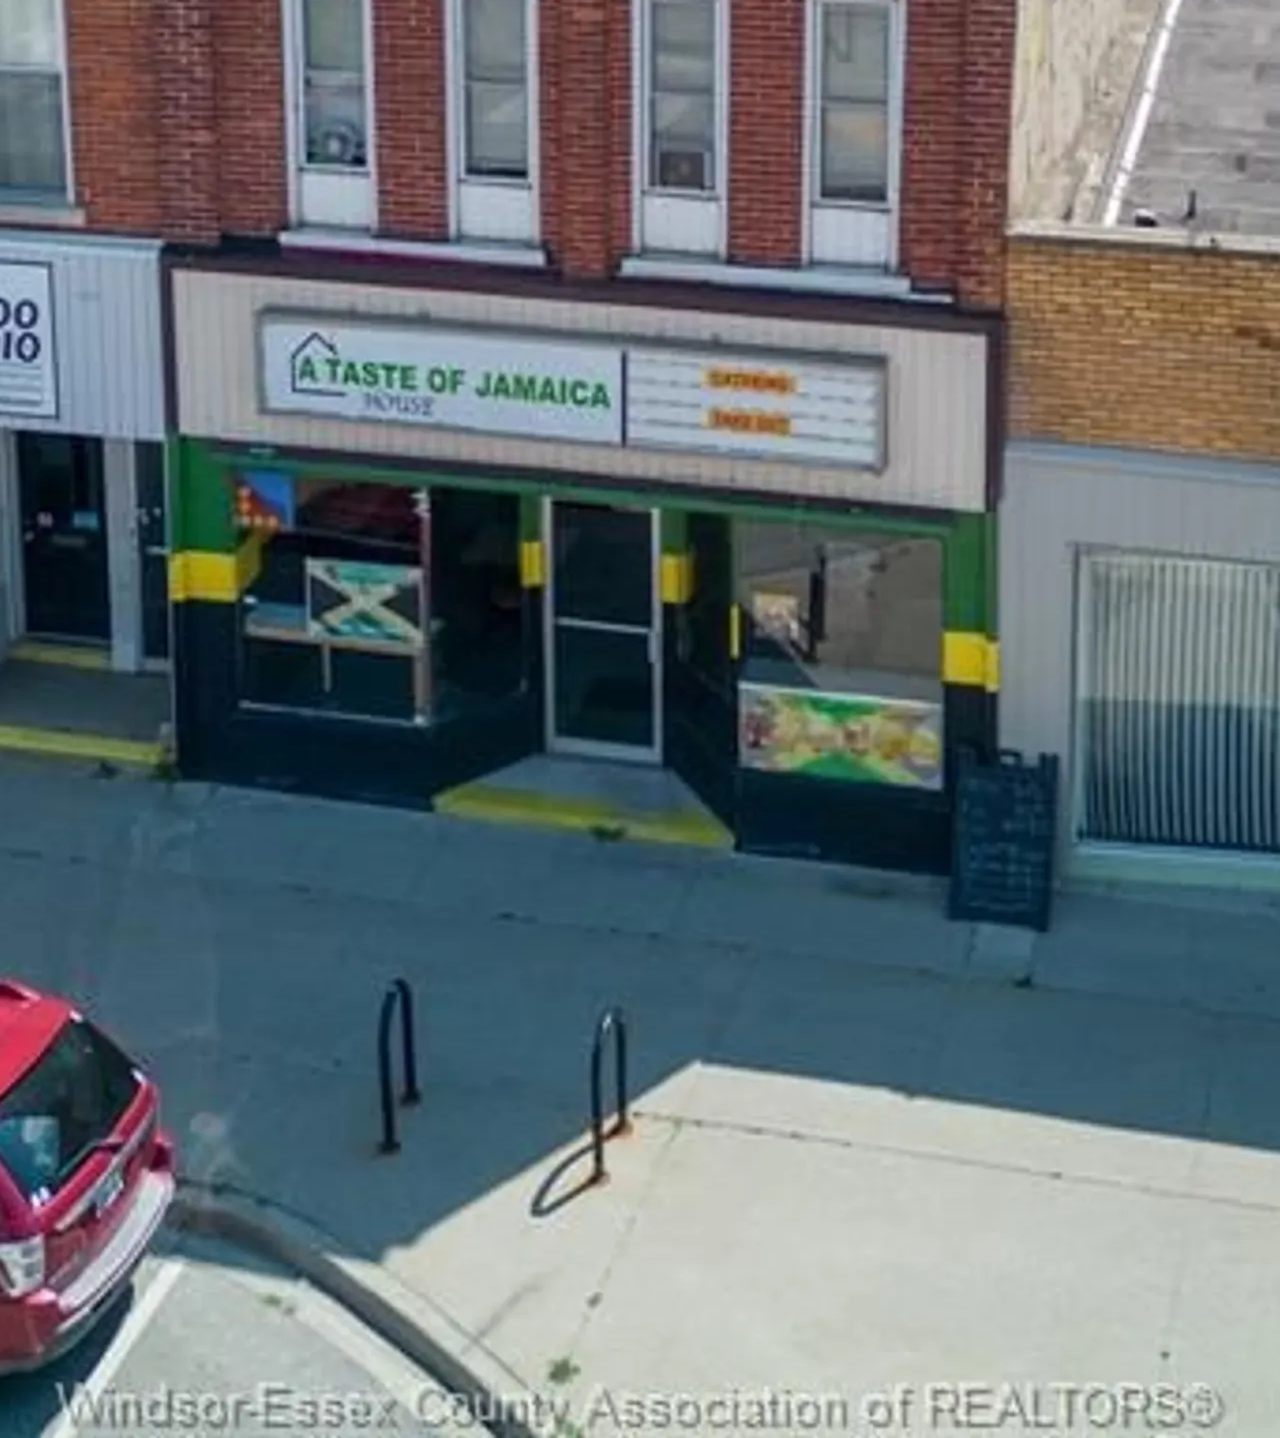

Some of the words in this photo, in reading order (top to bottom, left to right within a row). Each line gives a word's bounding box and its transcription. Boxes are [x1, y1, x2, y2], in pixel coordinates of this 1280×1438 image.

[298, 357, 319, 383] A
[324, 359, 418, 391] TASTE
[426, 368, 467, 394] OF
[475, 372, 612, 409] JAMAICA
